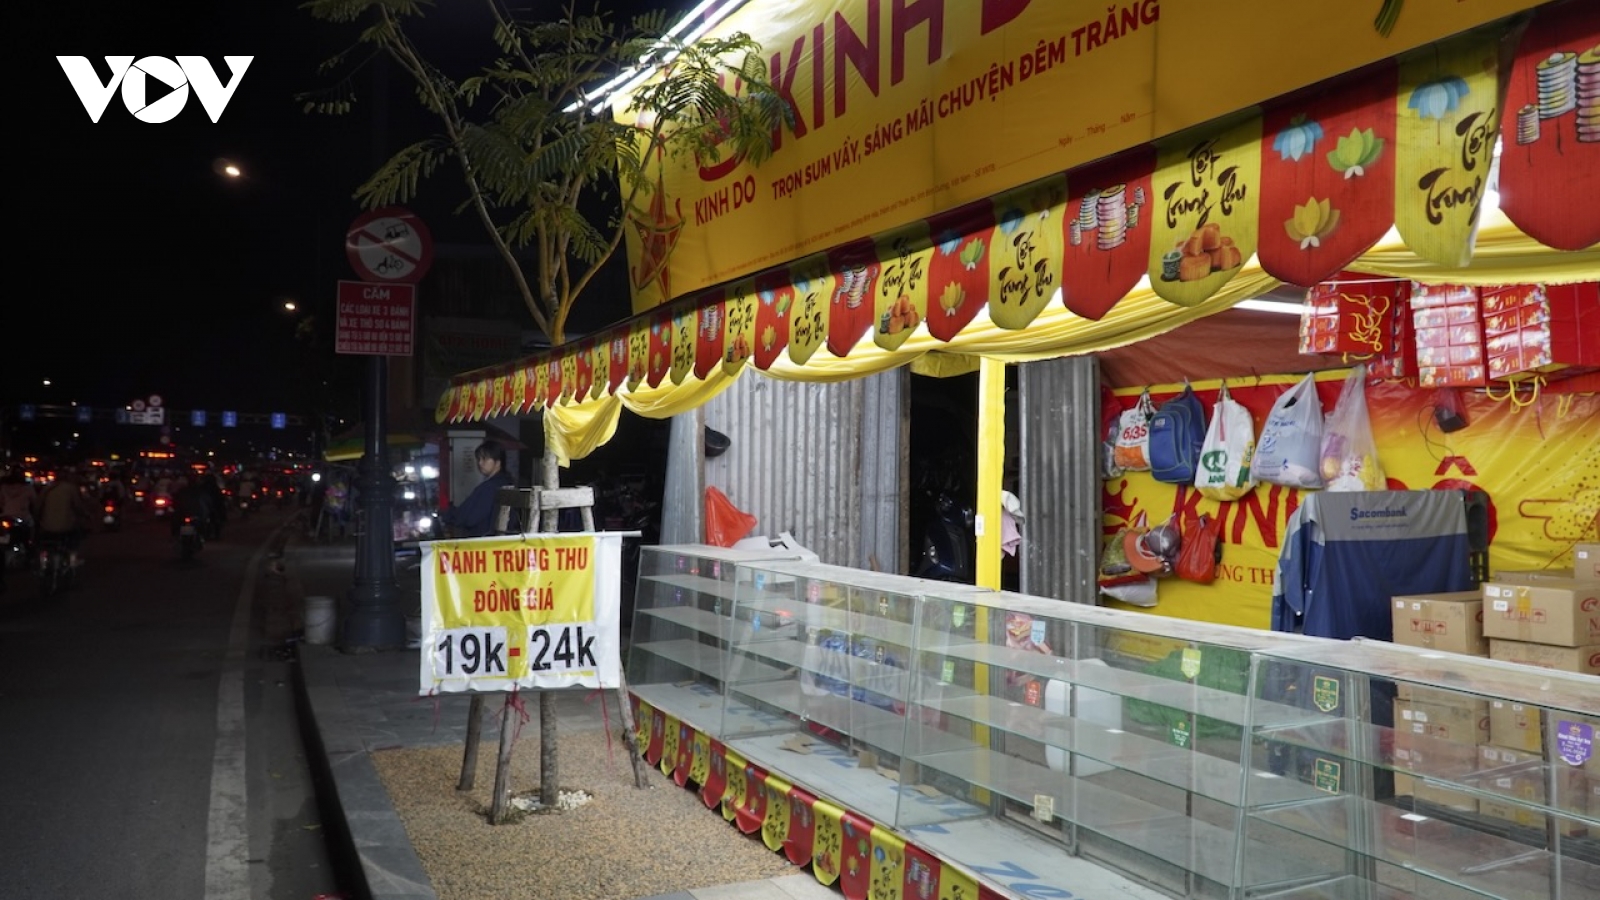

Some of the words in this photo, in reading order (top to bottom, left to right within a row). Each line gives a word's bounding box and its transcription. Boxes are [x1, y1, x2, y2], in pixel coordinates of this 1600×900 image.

[771, 169, 803, 201] TRỌN
[805, 155, 831, 185] SUM
[864, 118, 902, 157] SÁNG
[906, 97, 934, 136] MÃI
[938, 62, 1014, 119] CHUYỆN
[1019, 39, 1066, 82] ĐÊM
[1071, 0, 1160, 57] TRĂNG
[695, 187, 729, 227] KINH
[1351, 507, 1407, 520] Sacombank
[555, 547, 588, 571] THU
[474, 581, 520, 613] ĐỒNG
[526, 582, 554, 611] GIÁ
[438, 633, 505, 675] 19k
[531, 627, 597, 671] 24k
